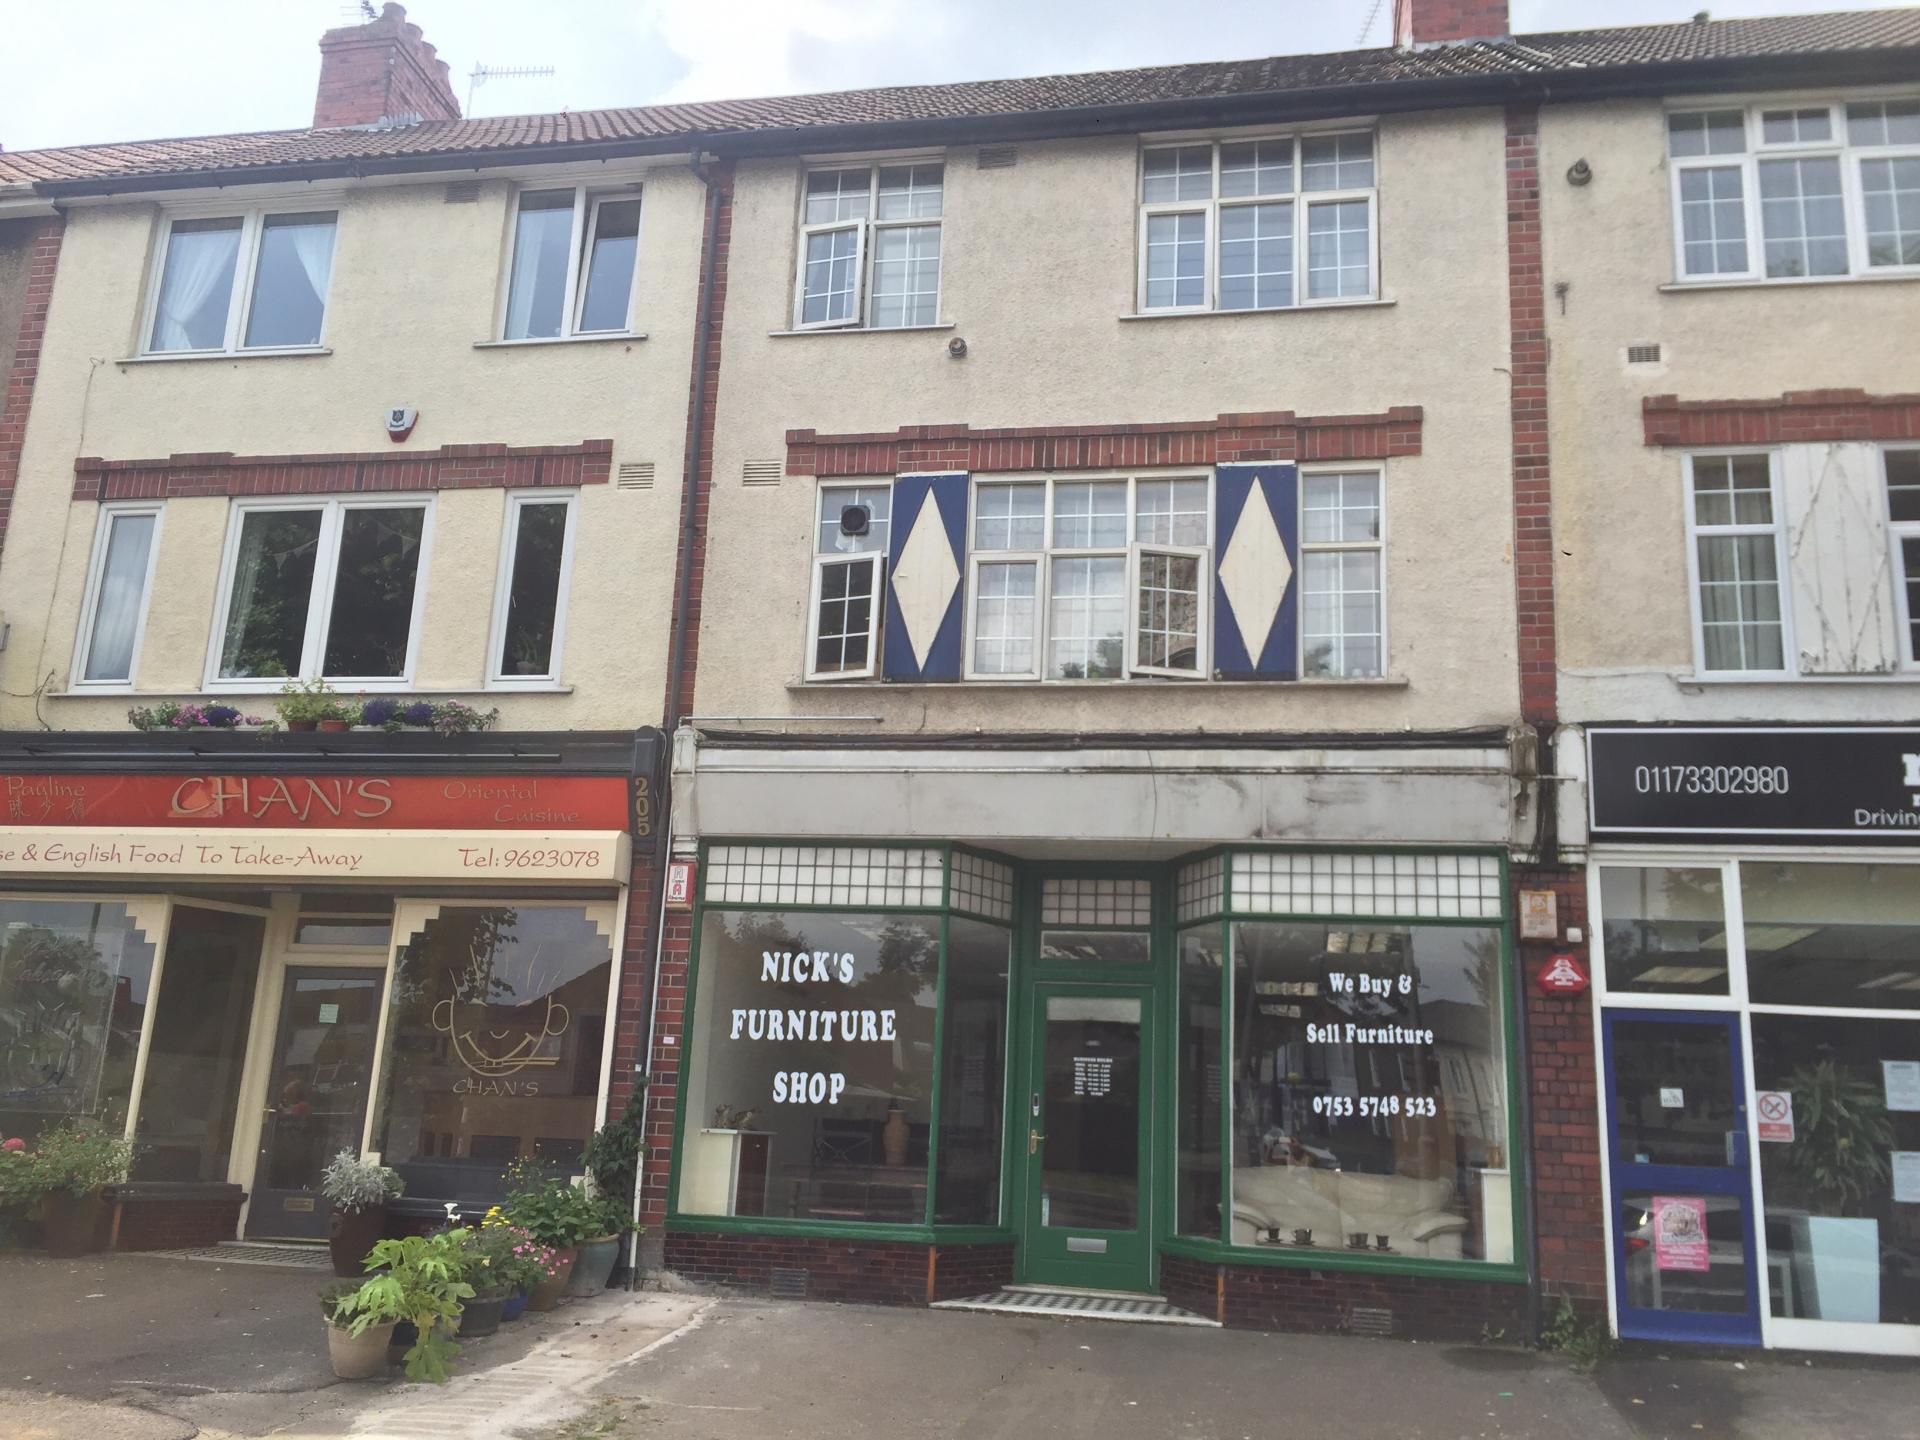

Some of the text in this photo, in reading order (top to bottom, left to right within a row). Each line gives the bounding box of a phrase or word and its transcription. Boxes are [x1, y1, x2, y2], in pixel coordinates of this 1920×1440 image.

[443, 780, 538, 800] Oriental
[1635, 765, 1790, 795] 01173302980
[171, 776, 393, 821] CHAN'S
[635, 777, 651, 836] 205
[494, 804, 581, 823] Cuisine
[1854, 808, 1920, 826] Drivin
[22, 843, 37, 862] &
[44, 843, 121, 868] English
[129, 844, 184, 863] Food
[196, 845, 223, 864] To
[230, 845, 363, 871] Take-Away
[761, 951, 856, 984] NICK'S
[1329, 972, 1412, 998] We Buy &
[730, 1009, 898, 1042] FURNITURE
[1307, 1023, 1434, 1045] Sell Furniture
[452, 1078, 539, 1096] CHAN'S
[772, 1071, 846, 1104] SHOP
[1313, 1095, 1436, 1117] 0753 5748 523
